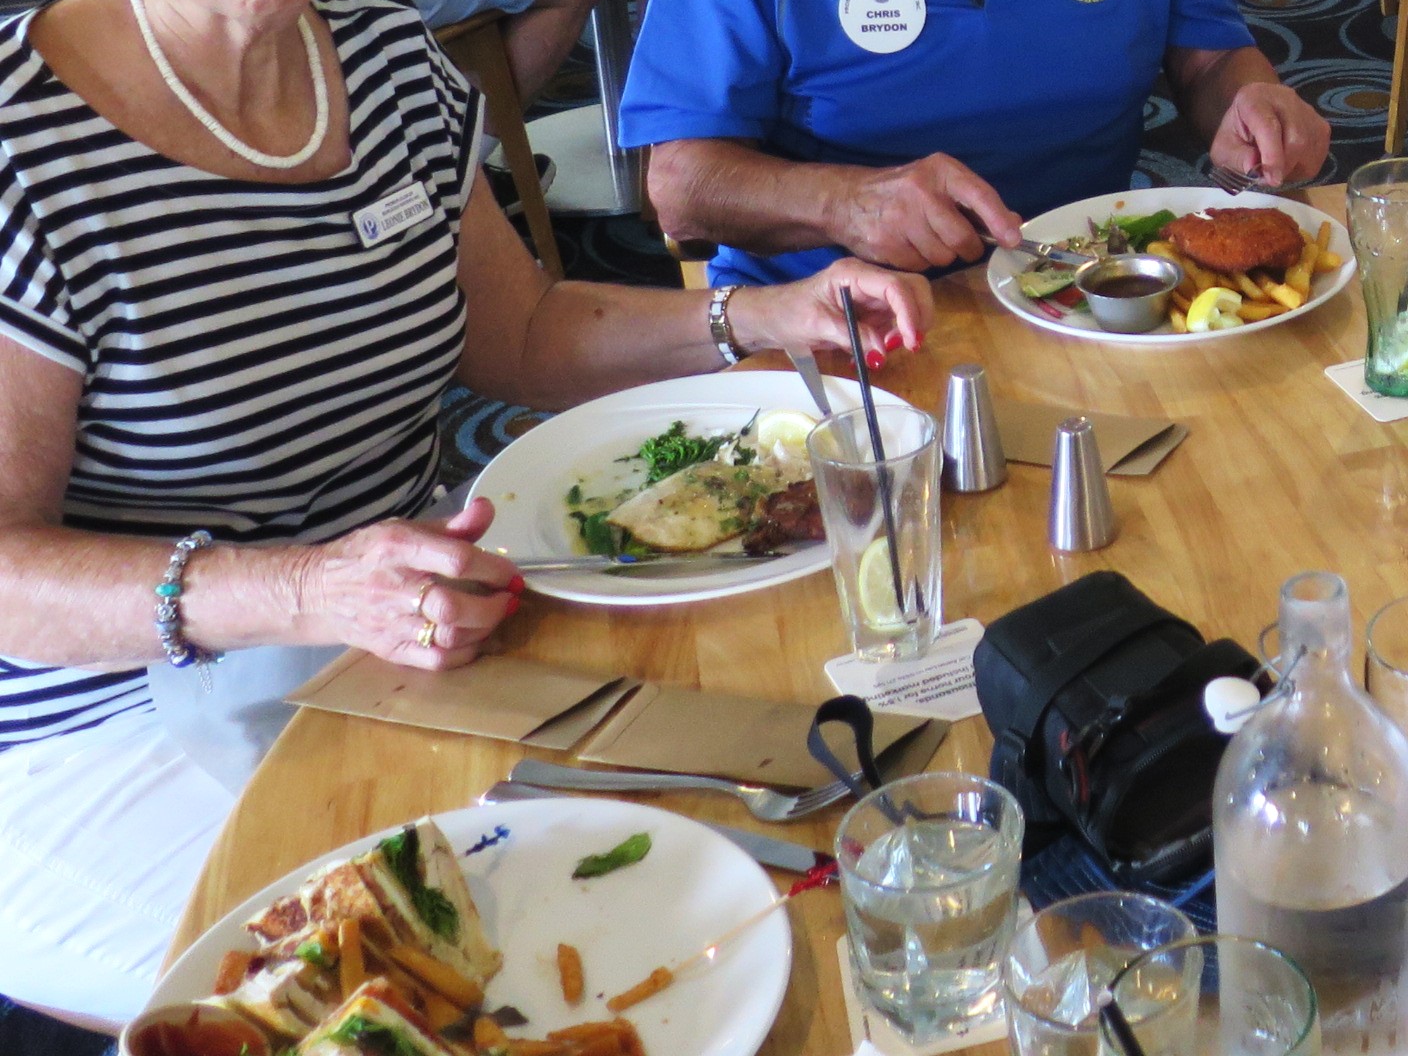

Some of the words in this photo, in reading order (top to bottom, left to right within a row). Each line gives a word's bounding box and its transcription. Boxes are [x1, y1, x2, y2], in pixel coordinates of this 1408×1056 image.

[866, 9, 901, 19] CHRIS
[861, 23, 908, 33] BRYDON
[915, 681, 977, 704] housands.
